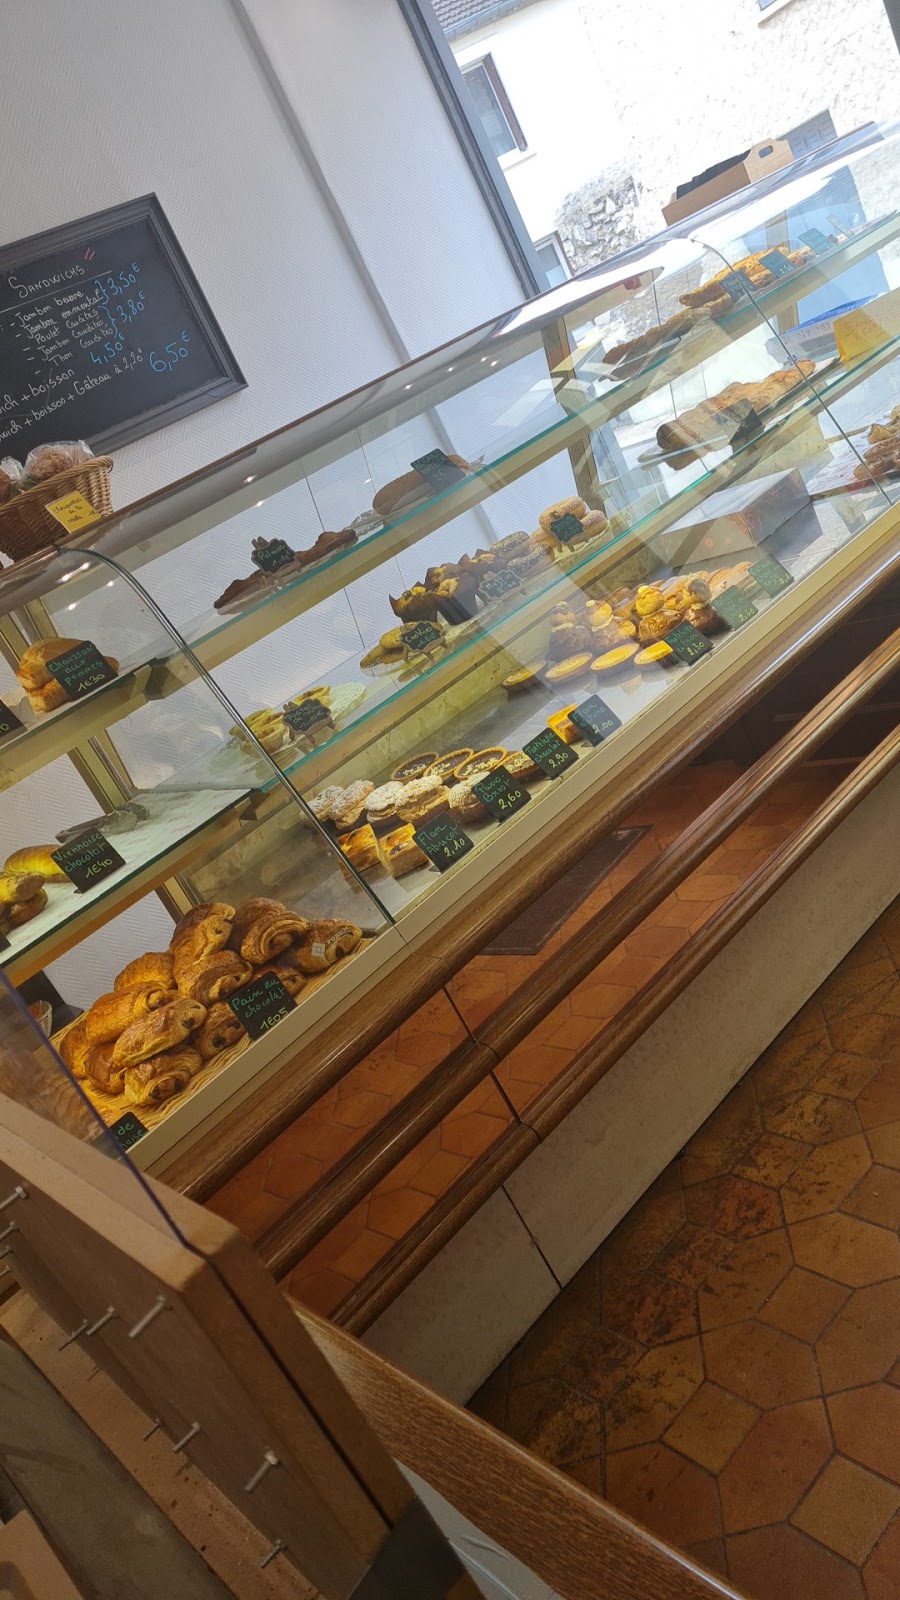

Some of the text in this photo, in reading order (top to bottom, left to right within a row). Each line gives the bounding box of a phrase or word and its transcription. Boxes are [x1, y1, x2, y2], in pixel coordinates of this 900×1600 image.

[8, 265, 85, 299] SANDWICHS
[15, 304, 53, 328] Jambon
[107, 262, 140, 296] 3,50€
[24, 288, 104, 339] Jambon emmental
[34, 326, 60, 345] Poulet
[116, 290, 146, 323] 3,80€
[37, 338, 70, 361] Jambon
[48, 350, 73, 366] Thon
[27, 368, 75, 397] boisson
[89, 332, 125, 365] 4,50€
[31, 397, 66, 421] boisson
[73, 373, 112, 395] Gâteau
[149, 330, 190, 372] 6,50€
[48, 644, 93, 672] Chausson
[64, 658, 86, 673] aux
[77, 673, 106, 692] 1€30
[571, 702, 597, 722] Flan
[592, 719, 614, 735] 2,00
[548, 752, 569, 769] 2,90
[498, 789, 522, 811] 2,60
[52, 831, 103, 861] Viennoise
[416, 823, 448, 846] Flan
[426, 823, 459, 855] Abricot
[64, 841, 106, 873] chocolat
[443, 838, 466, 858] 2,10
[85, 858, 114, 879] 1€40
[231, 978, 281, 1011] Pain au
[244, 986, 286, 1018] chocolat
[259, 1006, 289, 1030] 1€05
